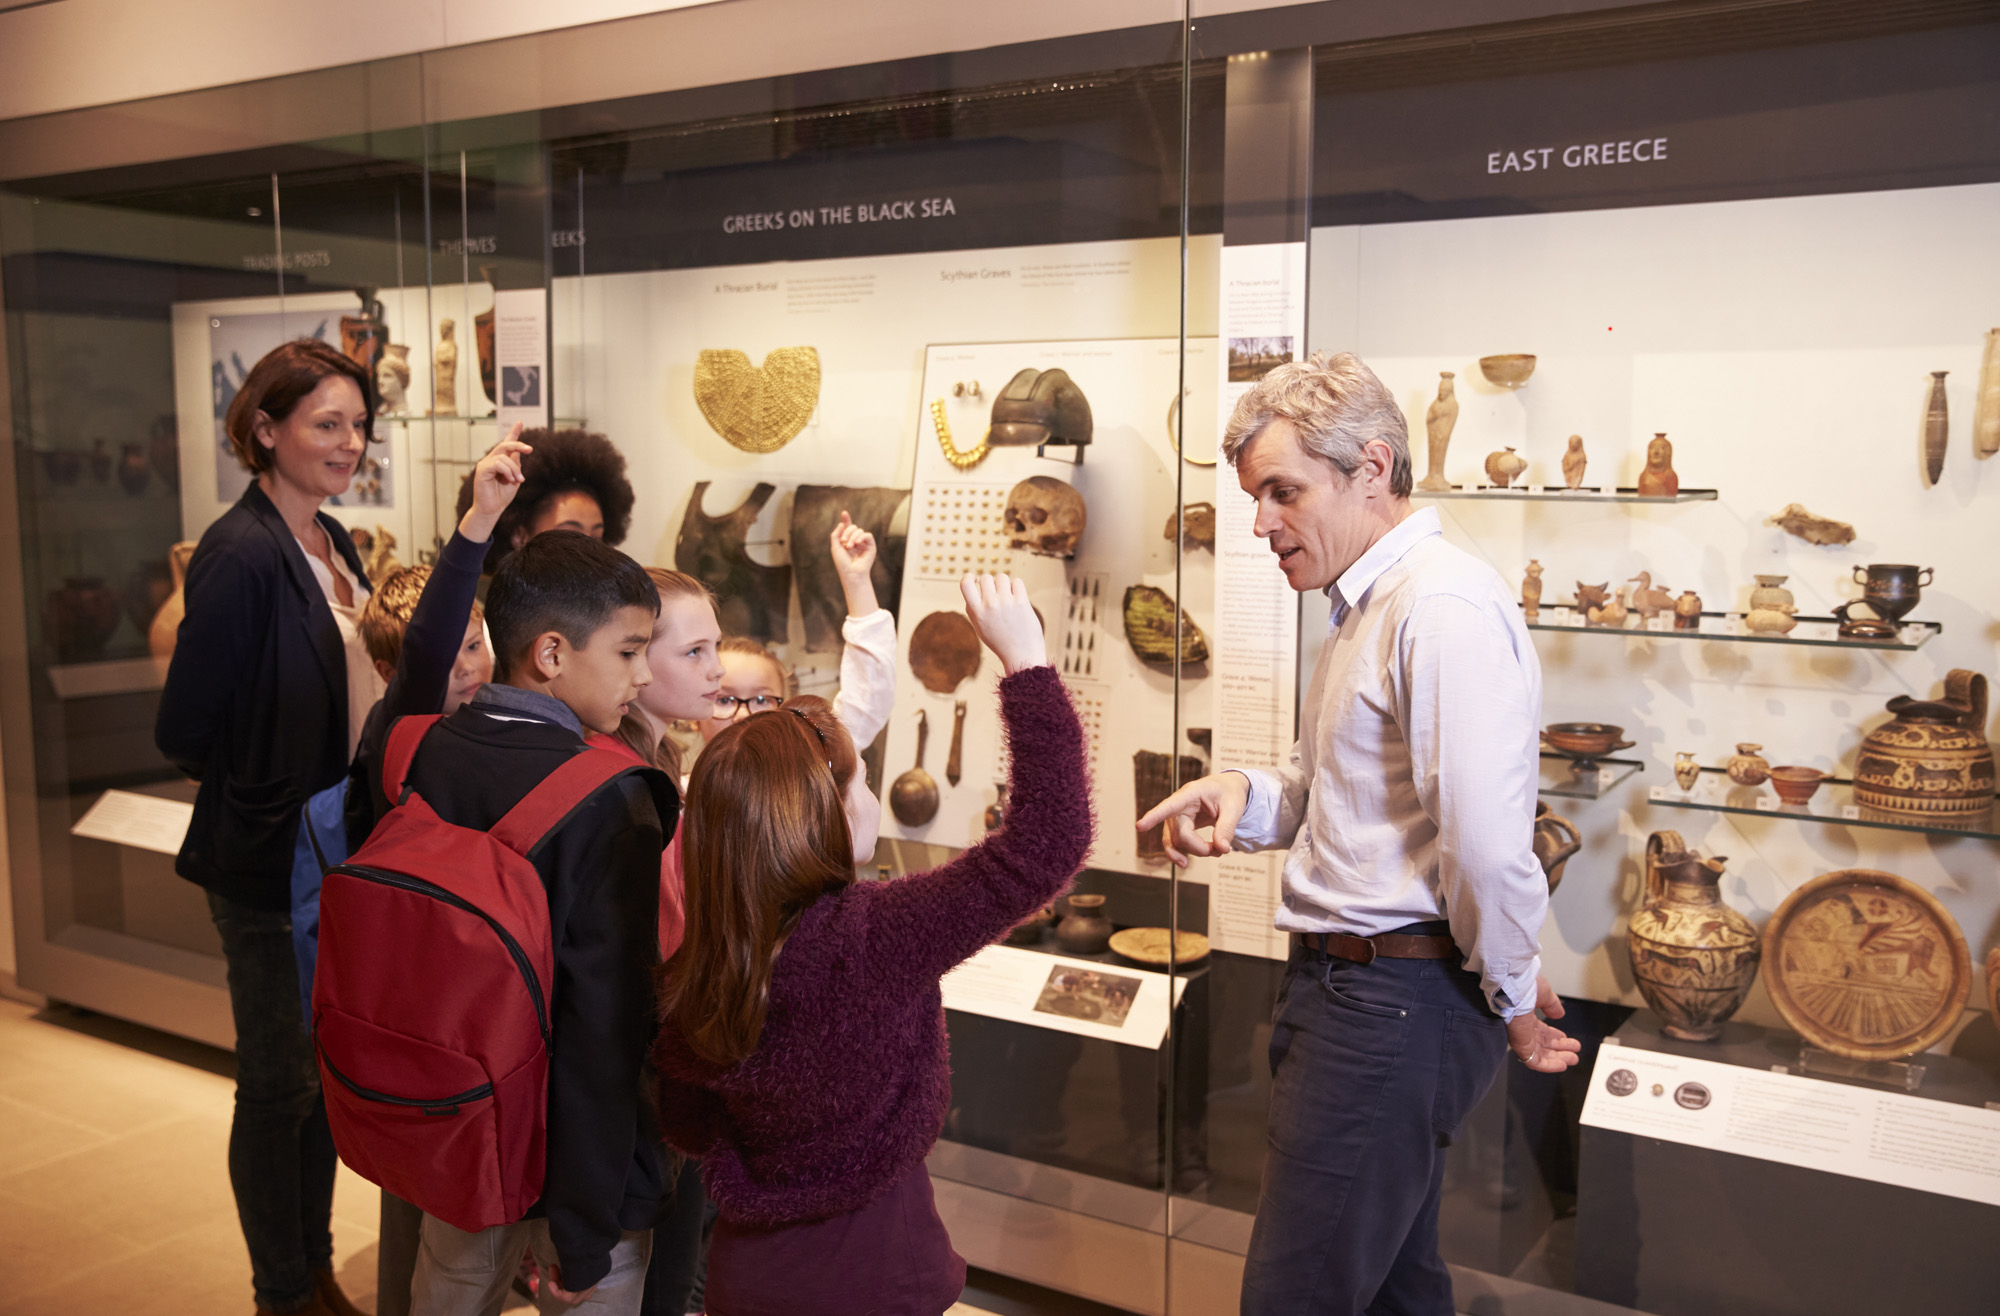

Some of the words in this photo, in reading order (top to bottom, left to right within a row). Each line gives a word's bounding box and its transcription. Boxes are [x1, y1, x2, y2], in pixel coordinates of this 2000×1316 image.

[1487, 147, 1554, 175] EAST
[1562, 137, 1668, 168] GREECE
[723, 210, 785, 235] GREEKS
[788, 208, 816, 230] ON
[819, 204, 853, 227] THE
[857, 199, 916, 224] BLACK
[920, 197, 957, 219] SEA
[551, 230, 587, 247] EEKS
[294, 249, 331, 269] POSTS
[940, 269, 978, 284] Scythian
[980, 267, 1012, 279] Graves
